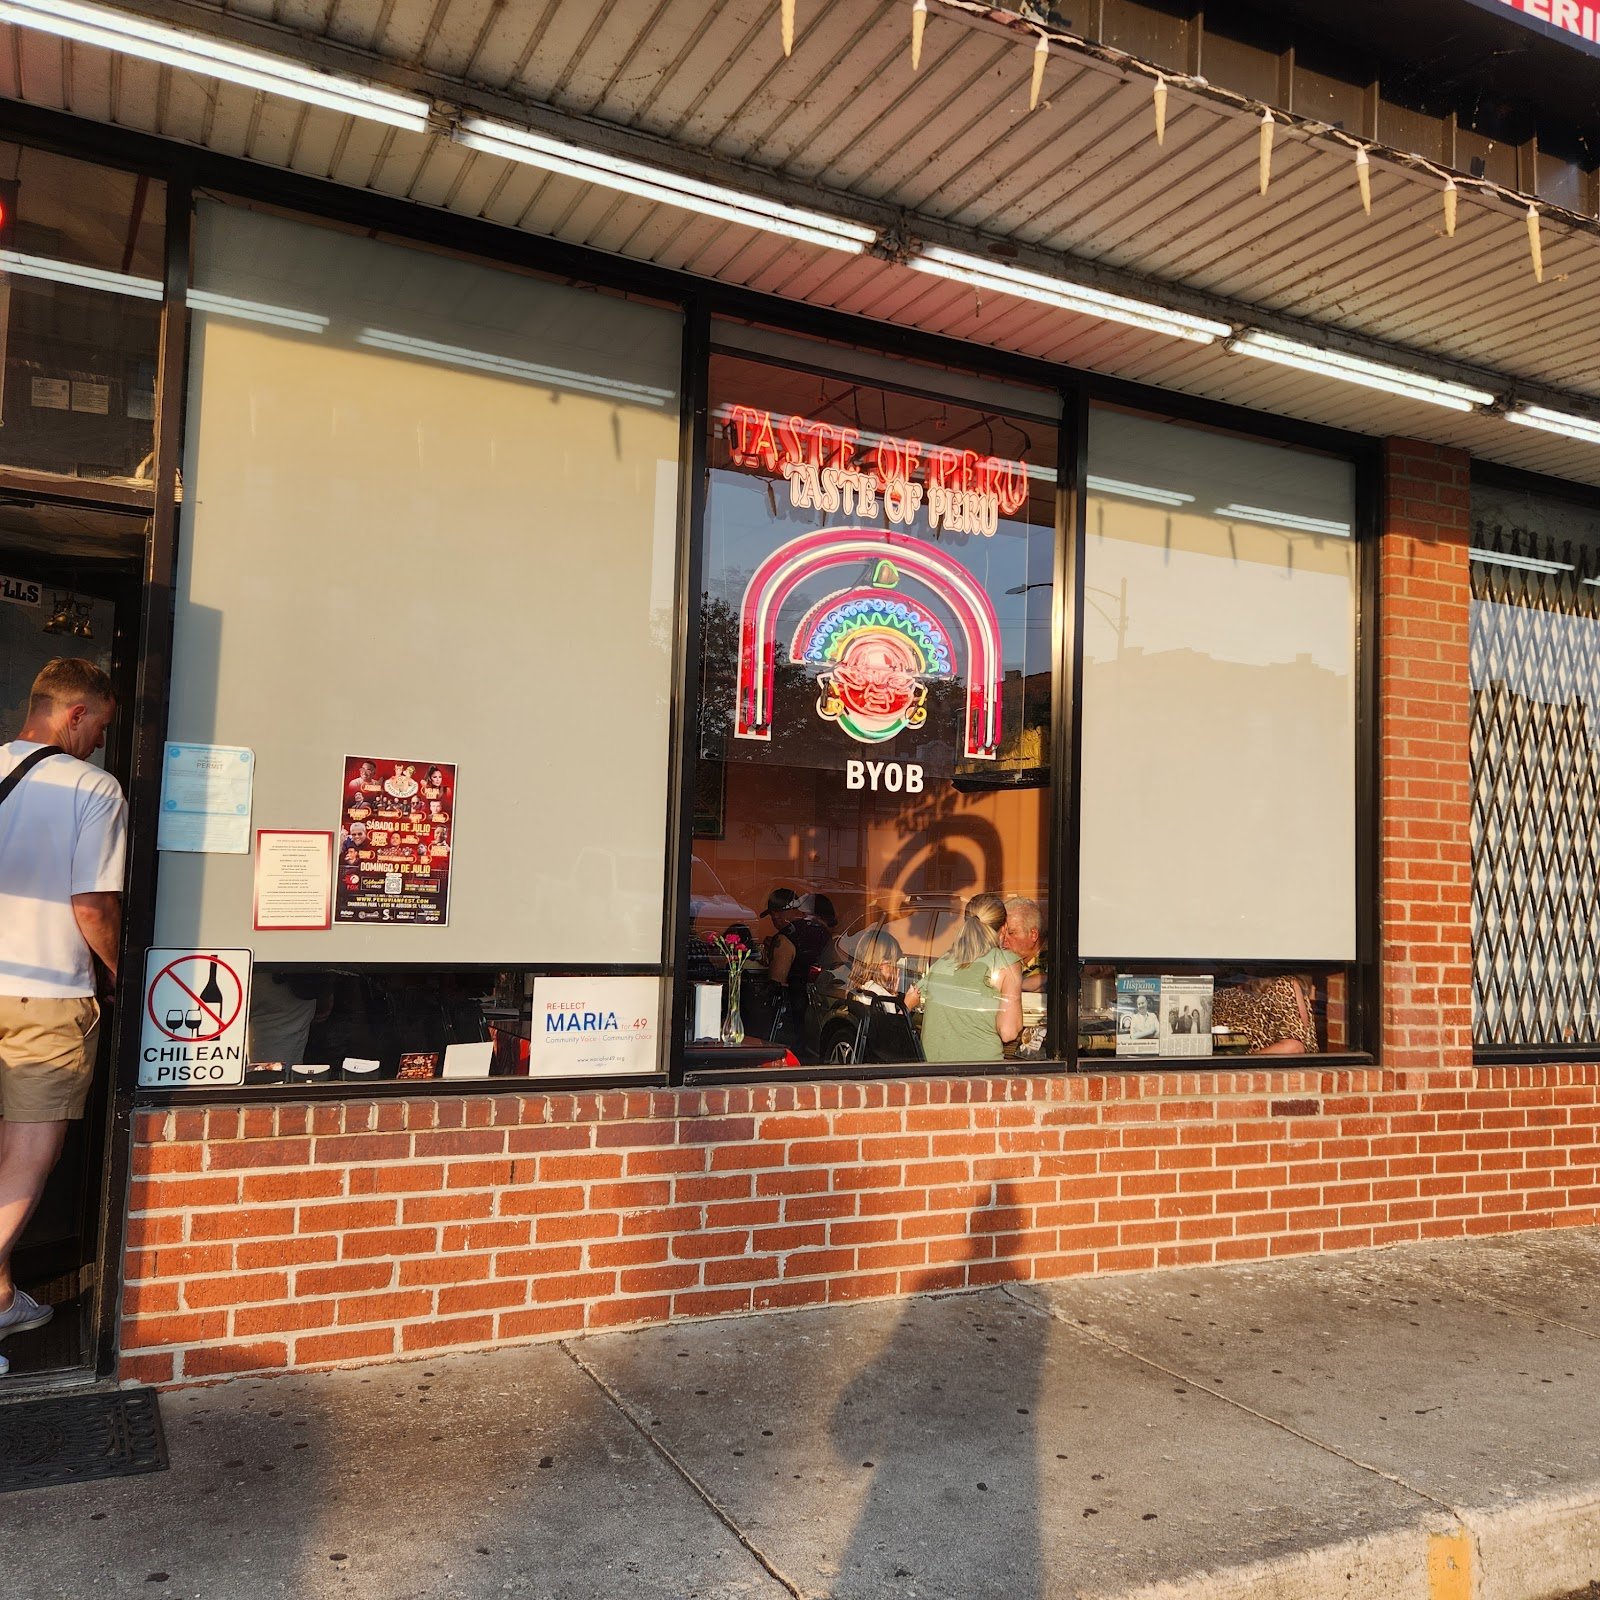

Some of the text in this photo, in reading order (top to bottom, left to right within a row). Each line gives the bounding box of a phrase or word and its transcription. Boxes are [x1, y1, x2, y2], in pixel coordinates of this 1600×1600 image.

[729, 405, 1029, 515] TASTE OF PERU
[784, 461, 999, 538] TASTE OF PERU
[196, 762, 224, 770] PERMIT
[847, 760, 923, 792] BYOB
[366, 820, 431, 833] SÁBADO 8 DE JULIO
[394, 864, 399, 872] 9
[401, 864, 410, 873] DE
[411, 864, 431, 874] JULIO
[356, 896, 429, 904] WWW.PERUVIANFEST.COM
[1123, 979, 1156, 991] Hispano
[546, 1002, 586, 1010] RE-ELECT
[546, 1012, 618, 1032] MARIA
[633, 1018, 647, 1030] 49
[545, 1035, 579, 1045] Community
[602, 1034, 634, 1042] Community
[143, 1046, 240, 1063] CHILEAN
[157, 1065, 224, 1081] PISCO
